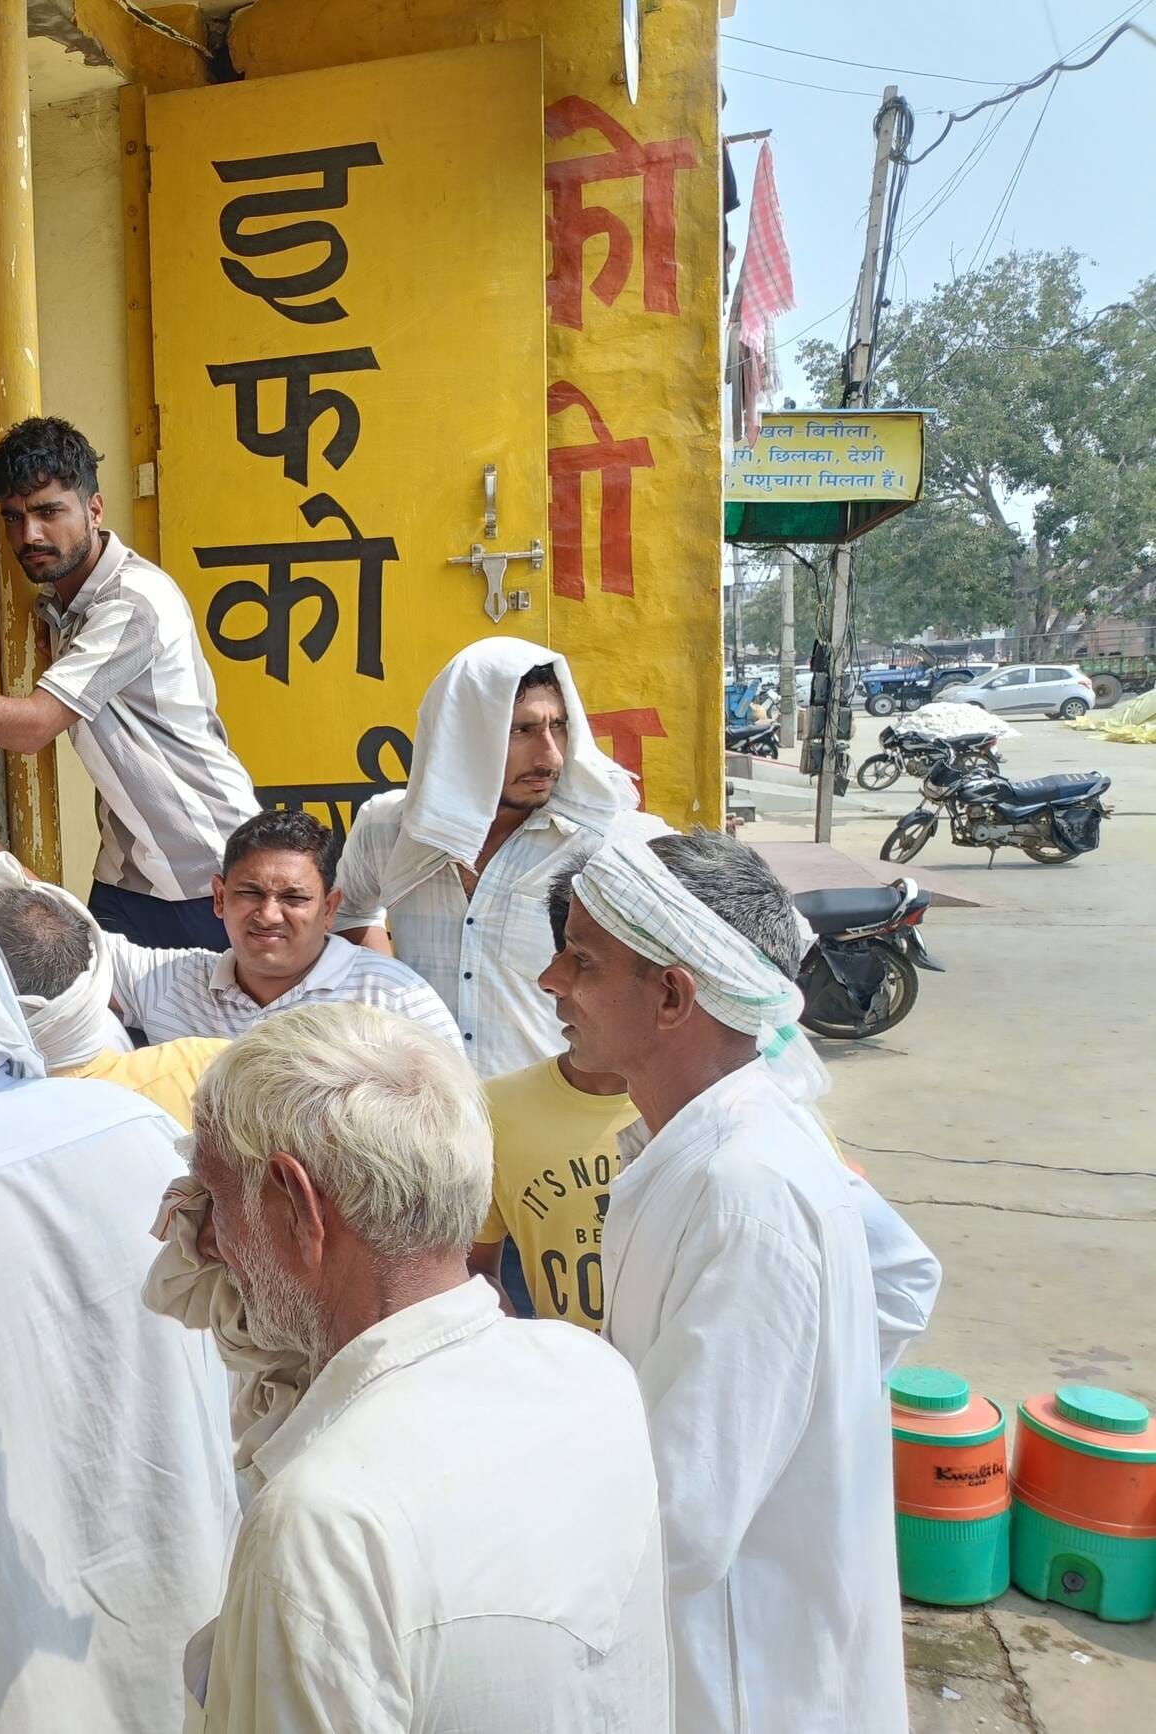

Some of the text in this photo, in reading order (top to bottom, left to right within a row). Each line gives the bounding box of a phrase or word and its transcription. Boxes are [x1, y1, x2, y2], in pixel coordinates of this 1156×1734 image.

[847, 445, 886, 465] देशी
[818, 470, 877, 488] मिलता
[521, 1153, 621, 1221] IT'S NO
